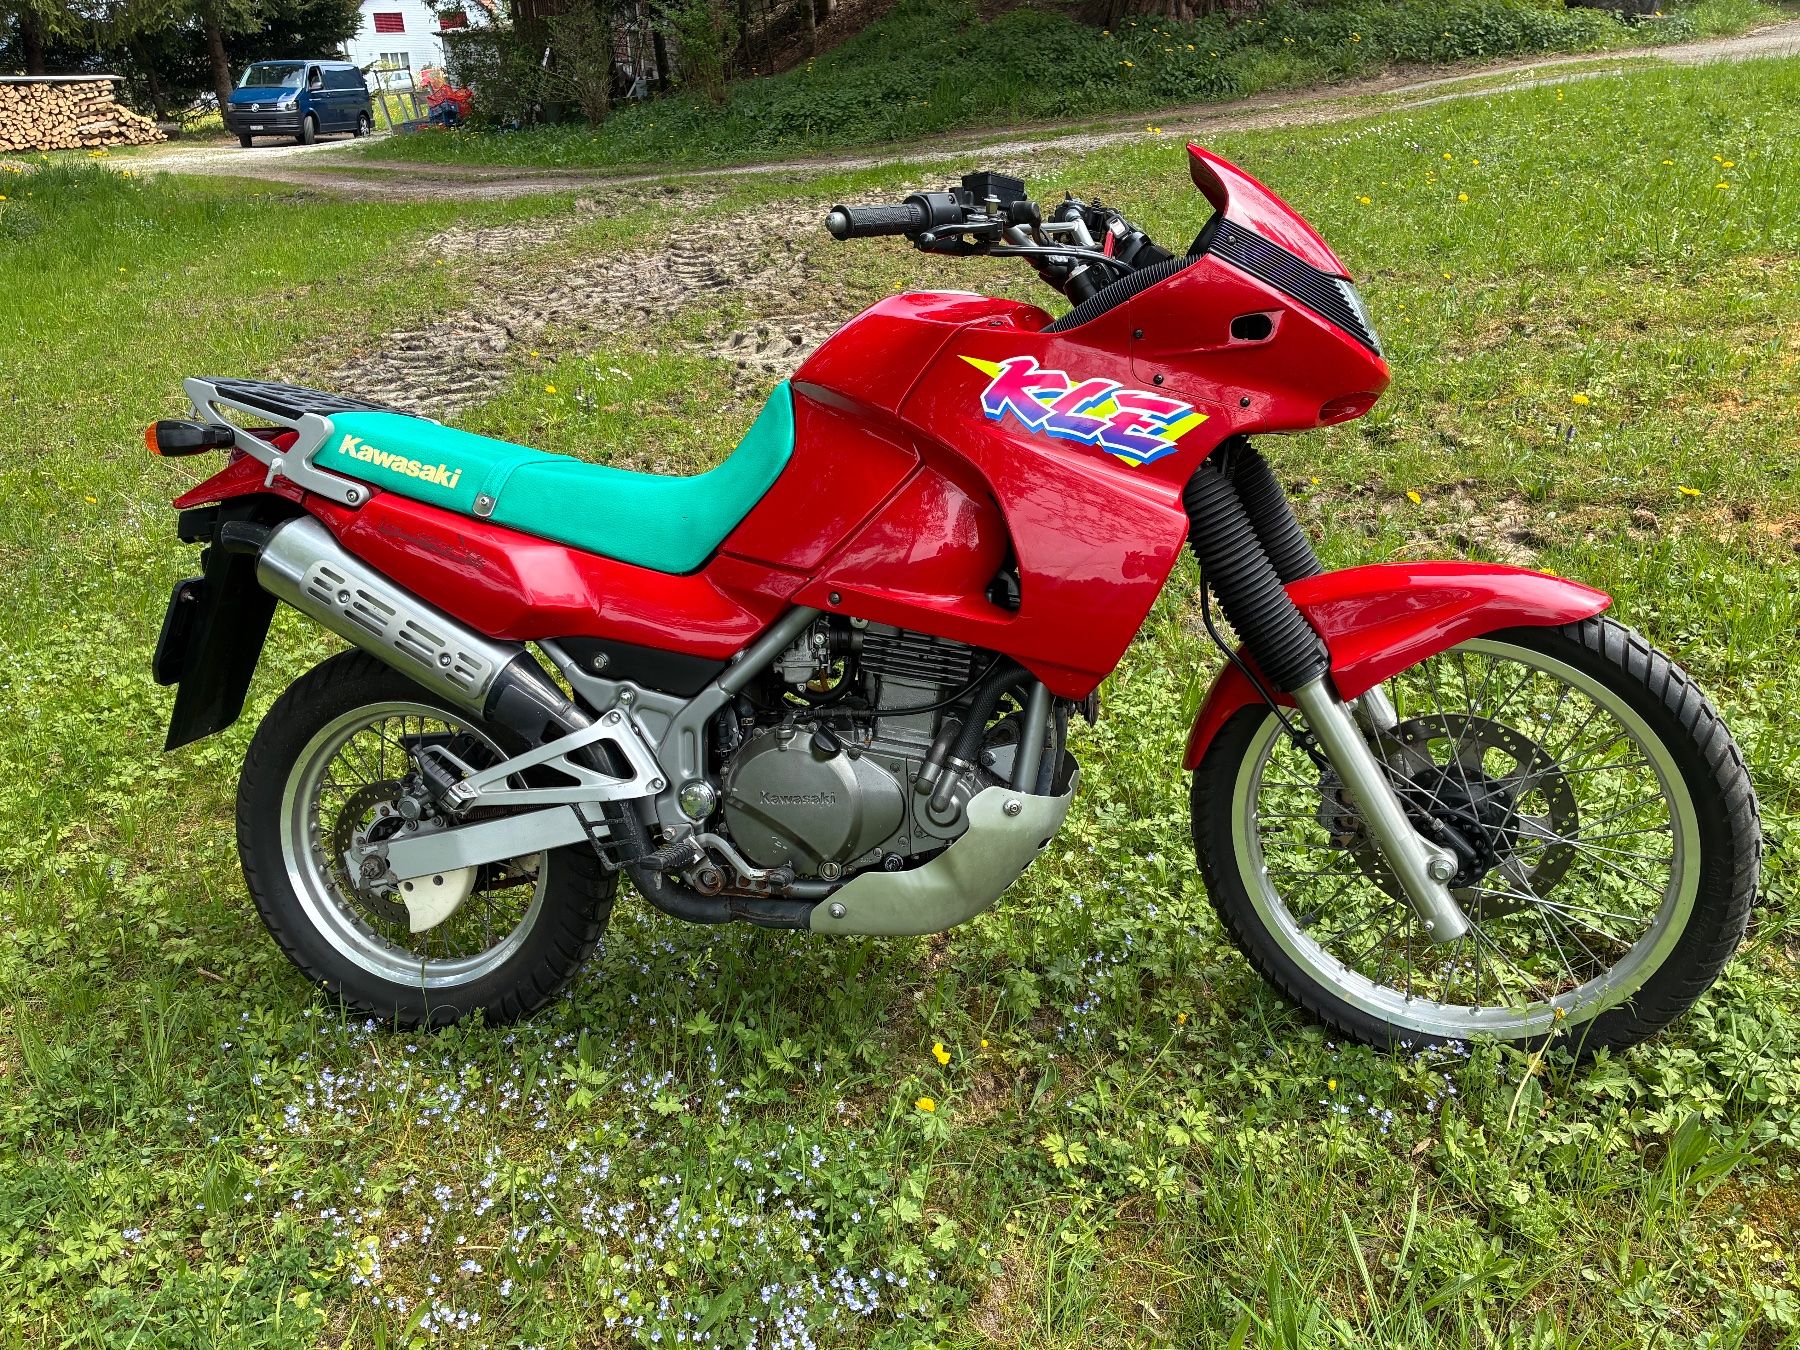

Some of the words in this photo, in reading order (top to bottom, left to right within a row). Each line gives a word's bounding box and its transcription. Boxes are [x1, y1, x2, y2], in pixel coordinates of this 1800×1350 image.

[980, 355, 1195, 465] KLE
[338, 434, 463, 489] Kawasaki
[759, 790, 836, 807] Kawasaki
